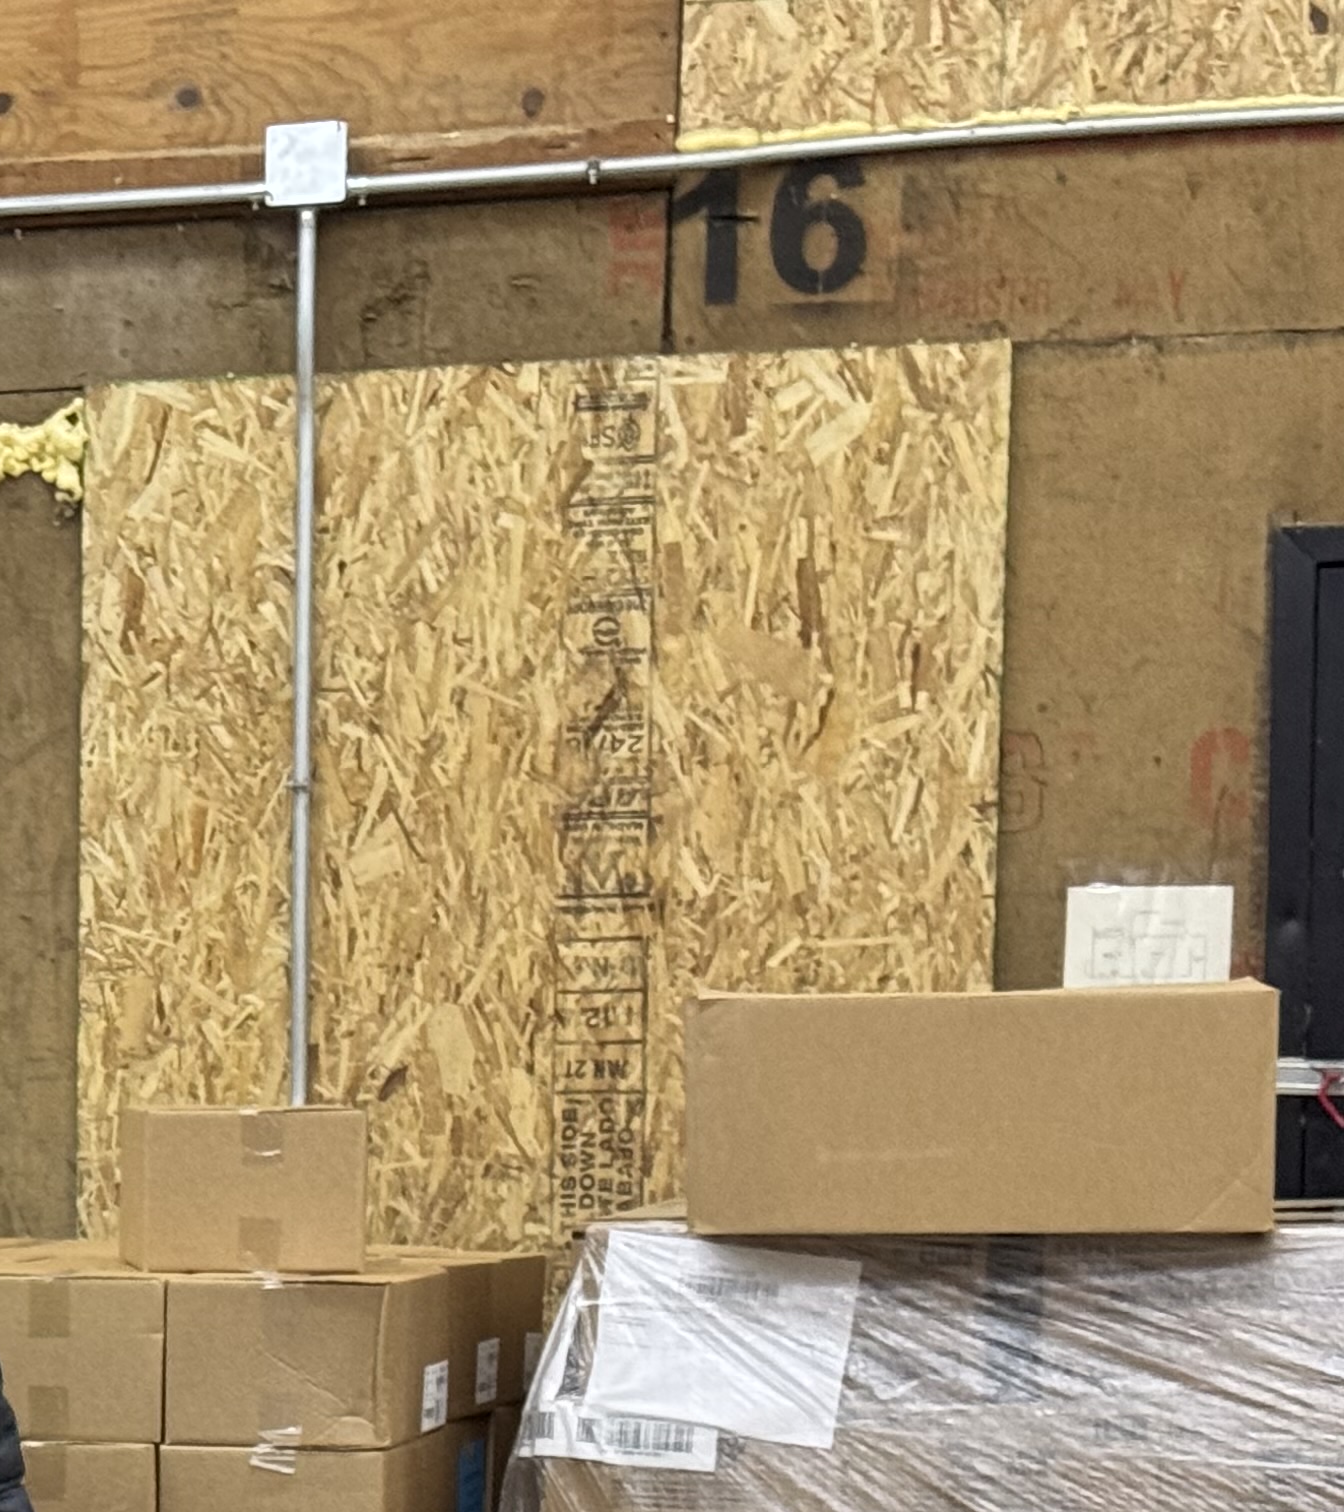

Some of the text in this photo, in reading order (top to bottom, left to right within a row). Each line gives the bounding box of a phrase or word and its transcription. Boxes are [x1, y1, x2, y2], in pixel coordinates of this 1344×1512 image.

[675, 160, 867, 305] 16
[560, 1108, 577, 1235] THIS SIDE
[579, 1132, 596, 1210] DOWN
